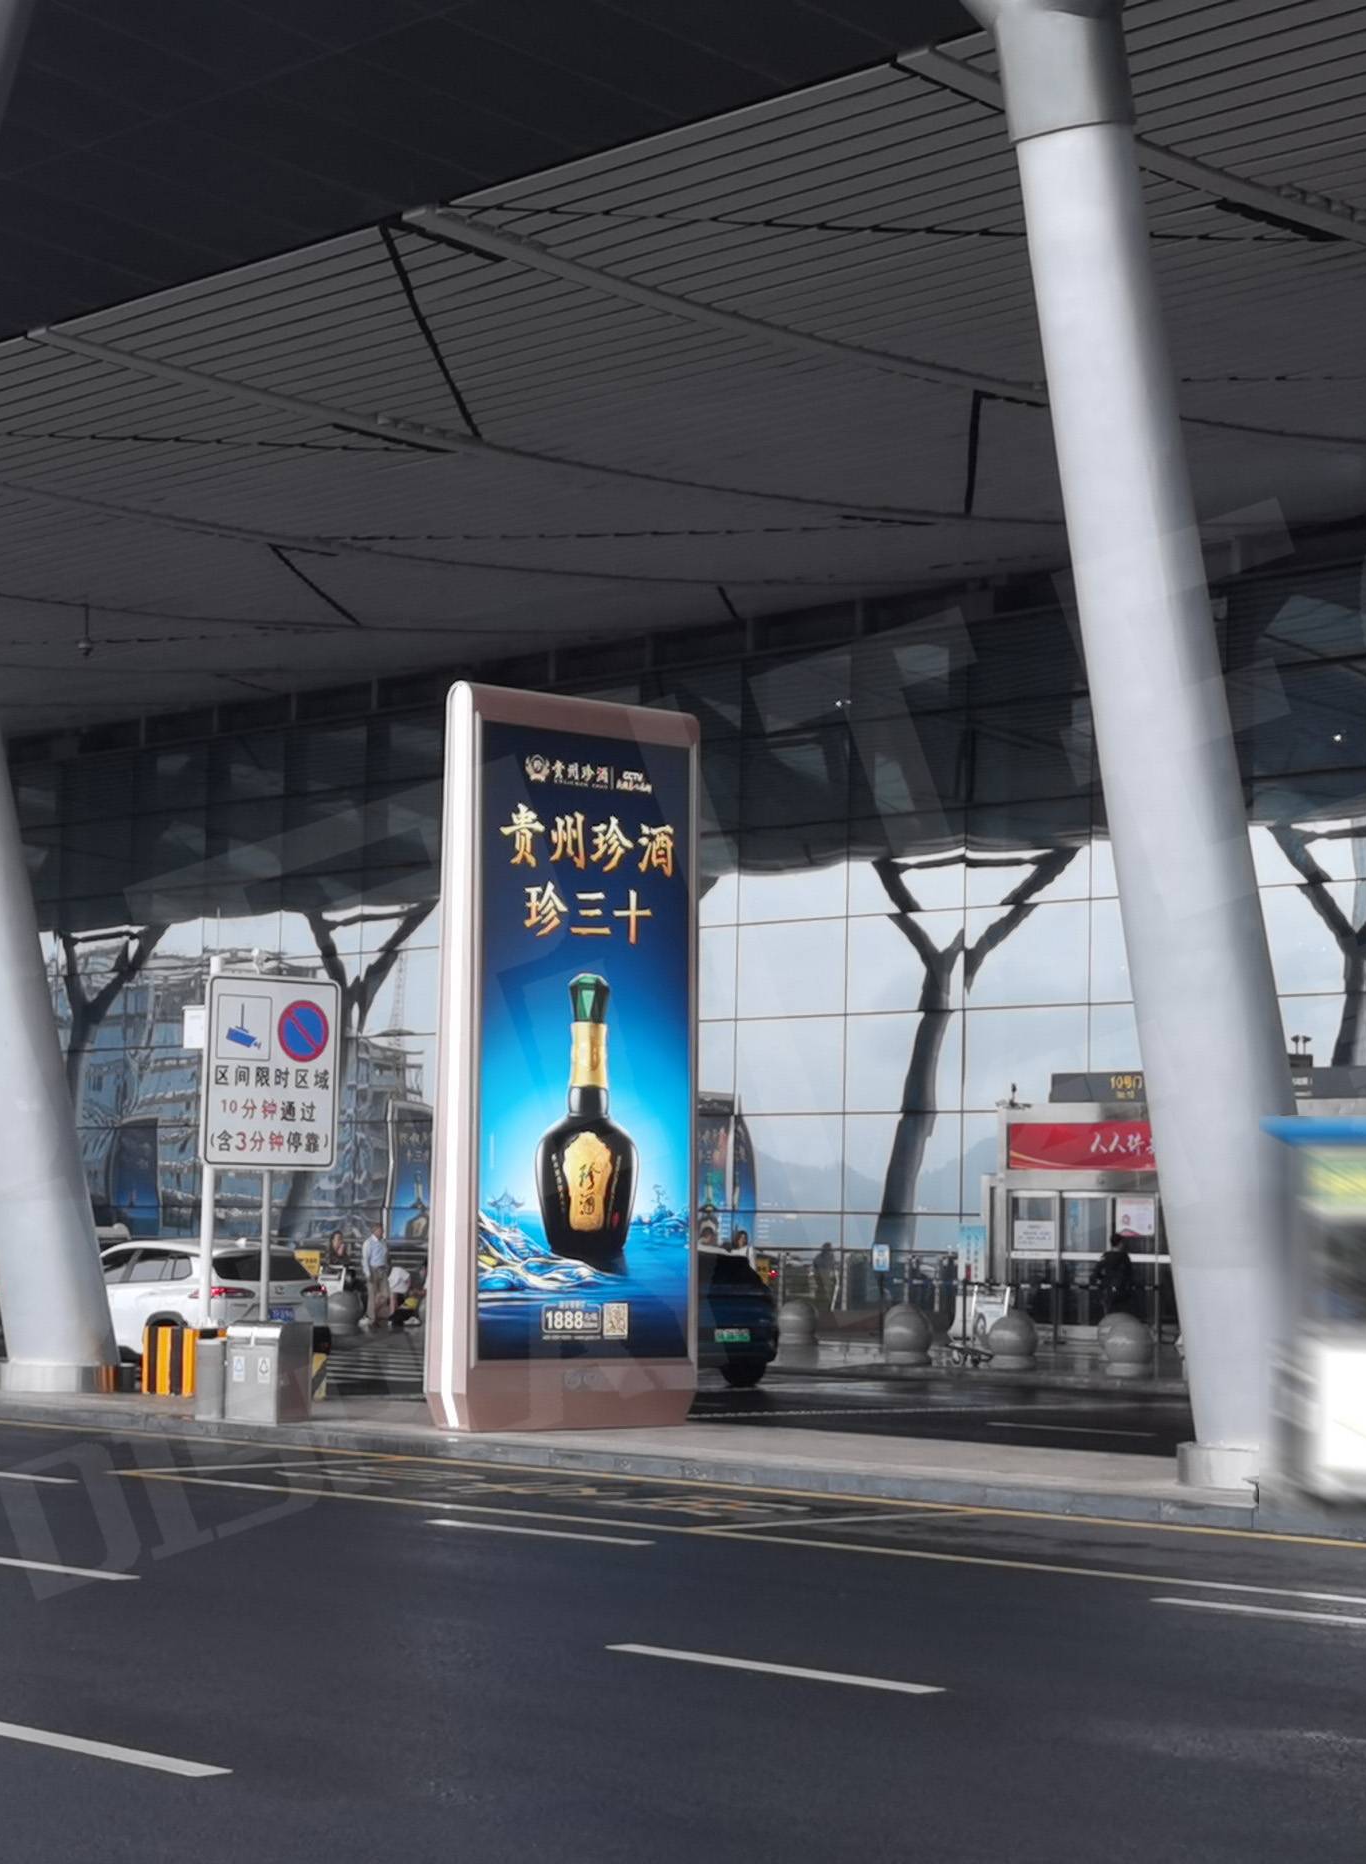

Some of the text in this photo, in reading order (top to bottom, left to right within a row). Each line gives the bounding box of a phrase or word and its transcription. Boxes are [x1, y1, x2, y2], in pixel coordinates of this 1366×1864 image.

[499, 802, 675, 878] 贵州珍酒
[523, 880, 653, 945] 珍三十
[215, 1065, 330, 1090] 区间限时区域
[220, 1099, 317, 1122] 10分钟通过
[545, 1310, 584, 1329] 1888
